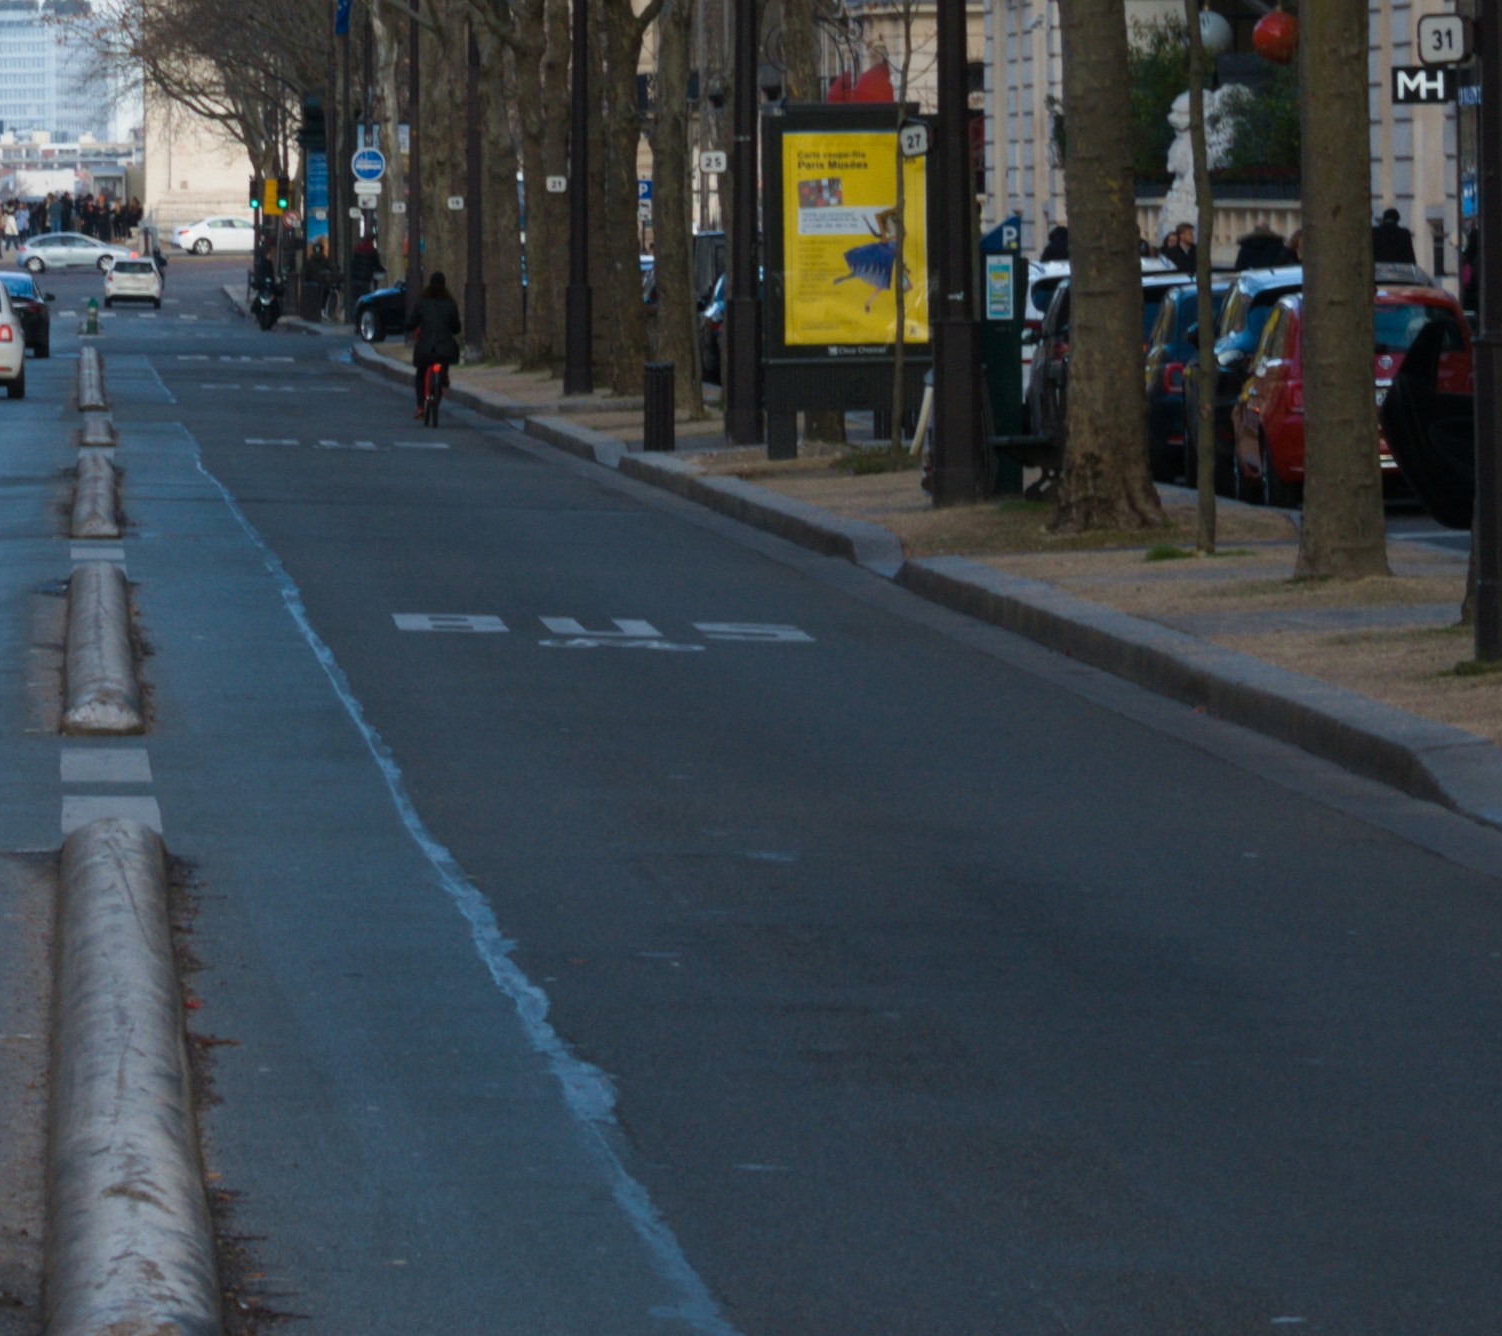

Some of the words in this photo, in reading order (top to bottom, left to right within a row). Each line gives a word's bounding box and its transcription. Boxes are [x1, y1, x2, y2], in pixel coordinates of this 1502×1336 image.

[1432, 29, 1453, 50] 31
[1397, 70, 1444, 100] MH
[907, 133, 921, 149] 27
[706, 158, 722, 168] 25
[797, 161, 824, 170] Paris
[1002, 226, 1018, 248] P
